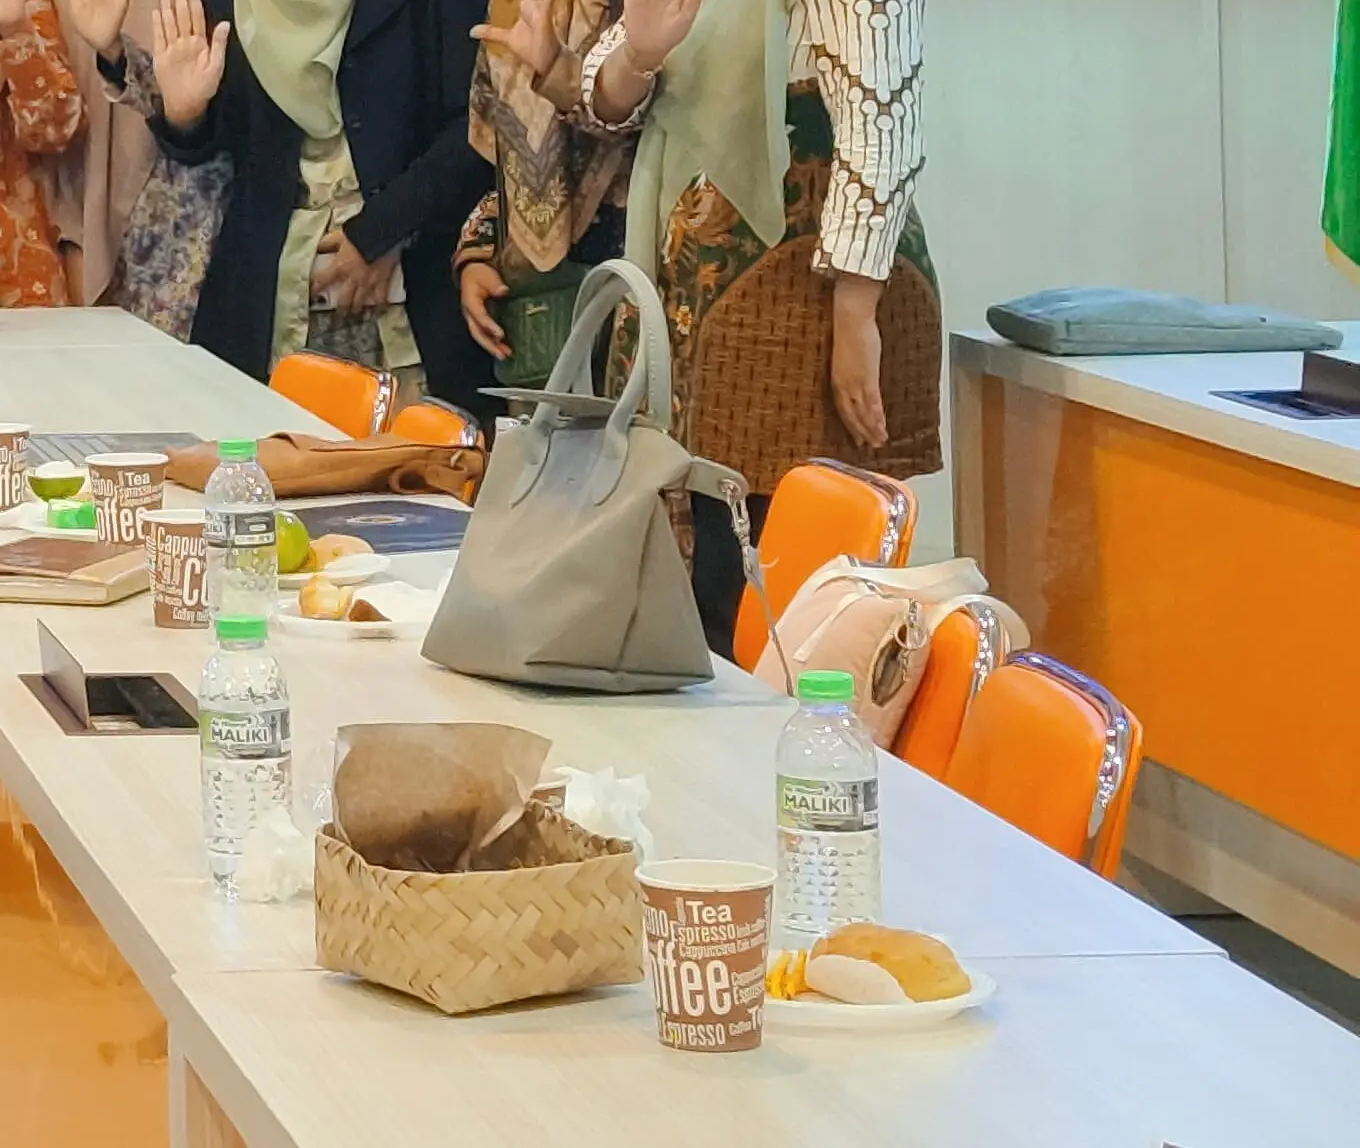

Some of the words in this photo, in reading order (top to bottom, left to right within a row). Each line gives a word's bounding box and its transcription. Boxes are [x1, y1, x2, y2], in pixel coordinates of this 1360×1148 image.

[124, 471, 150, 487] Tea
[95, 497, 145, 543] offee
[211, 724, 268, 743] MALIKI
[784, 794, 848, 813] MALIKI
[685, 900, 733, 925] Tea
[669, 920, 737, 946] Espresso
